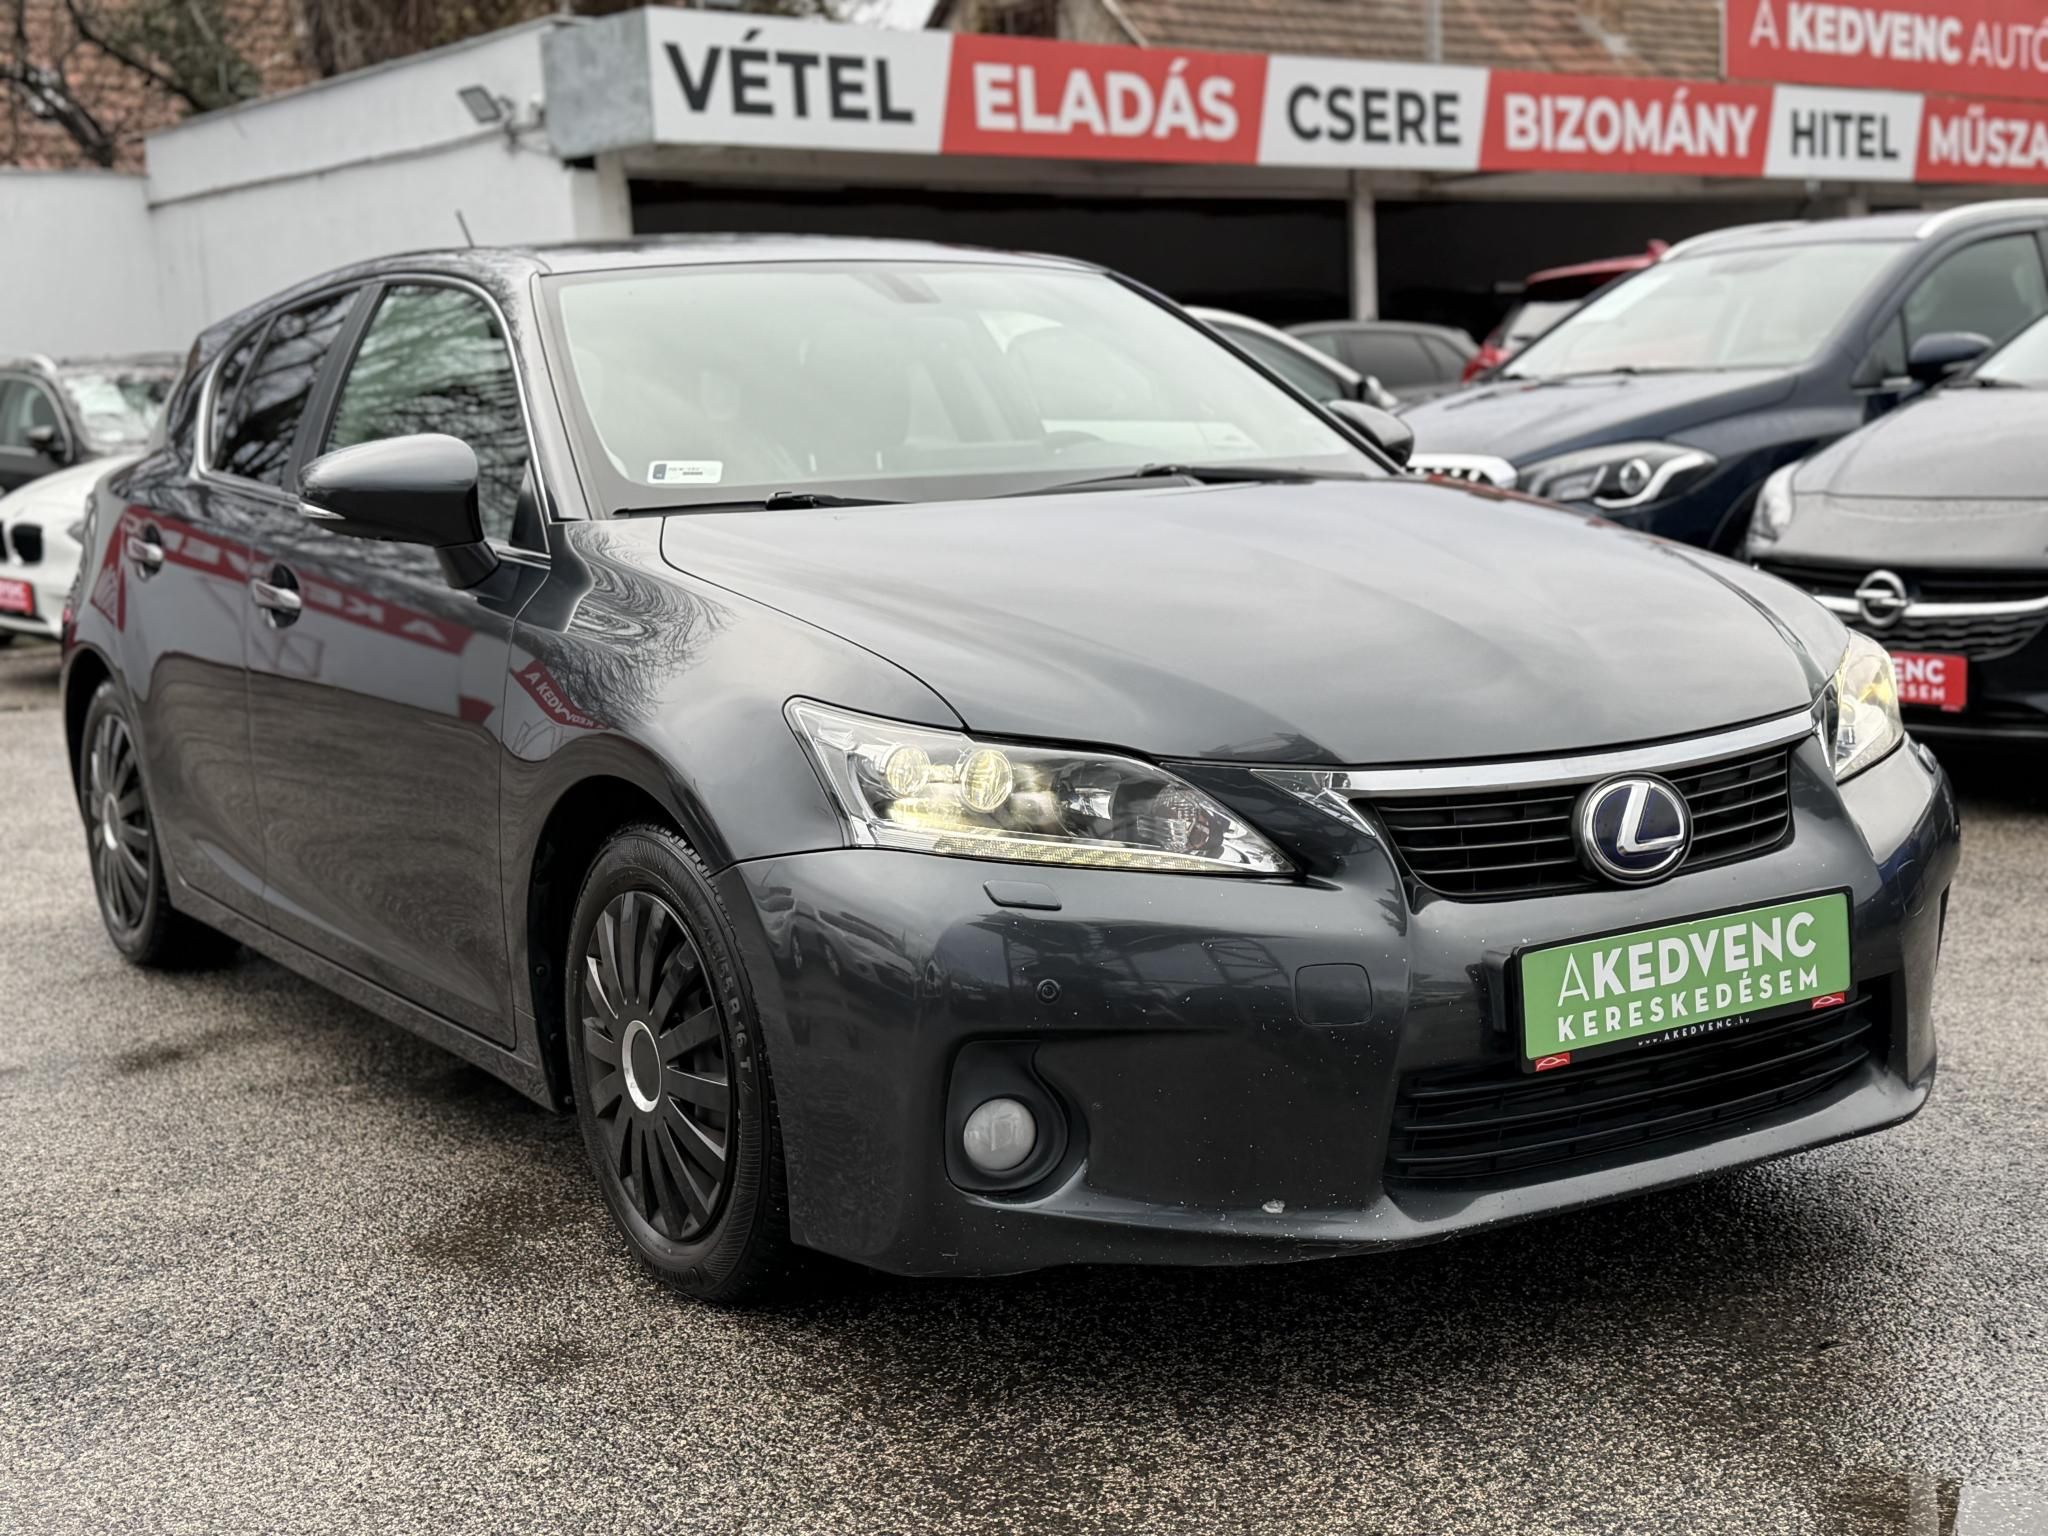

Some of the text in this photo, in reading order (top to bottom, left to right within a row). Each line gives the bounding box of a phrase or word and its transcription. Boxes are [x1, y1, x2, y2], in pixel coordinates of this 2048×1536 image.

[1749, 0, 1780, 48] A
[1787, 1, 1964, 64] KEDVENC
[664, 29, 914, 123] VÉTEL
[972, 59, 1240, 140] ELADÁS
[1287, 84, 1462, 146] CSERE
[1504, 88, 1758, 158] BIZOMÁNY
[1790, 109, 1900, 161] HITEL
[1558, 965, 1819, 1042] KERESKEDÉSEM
